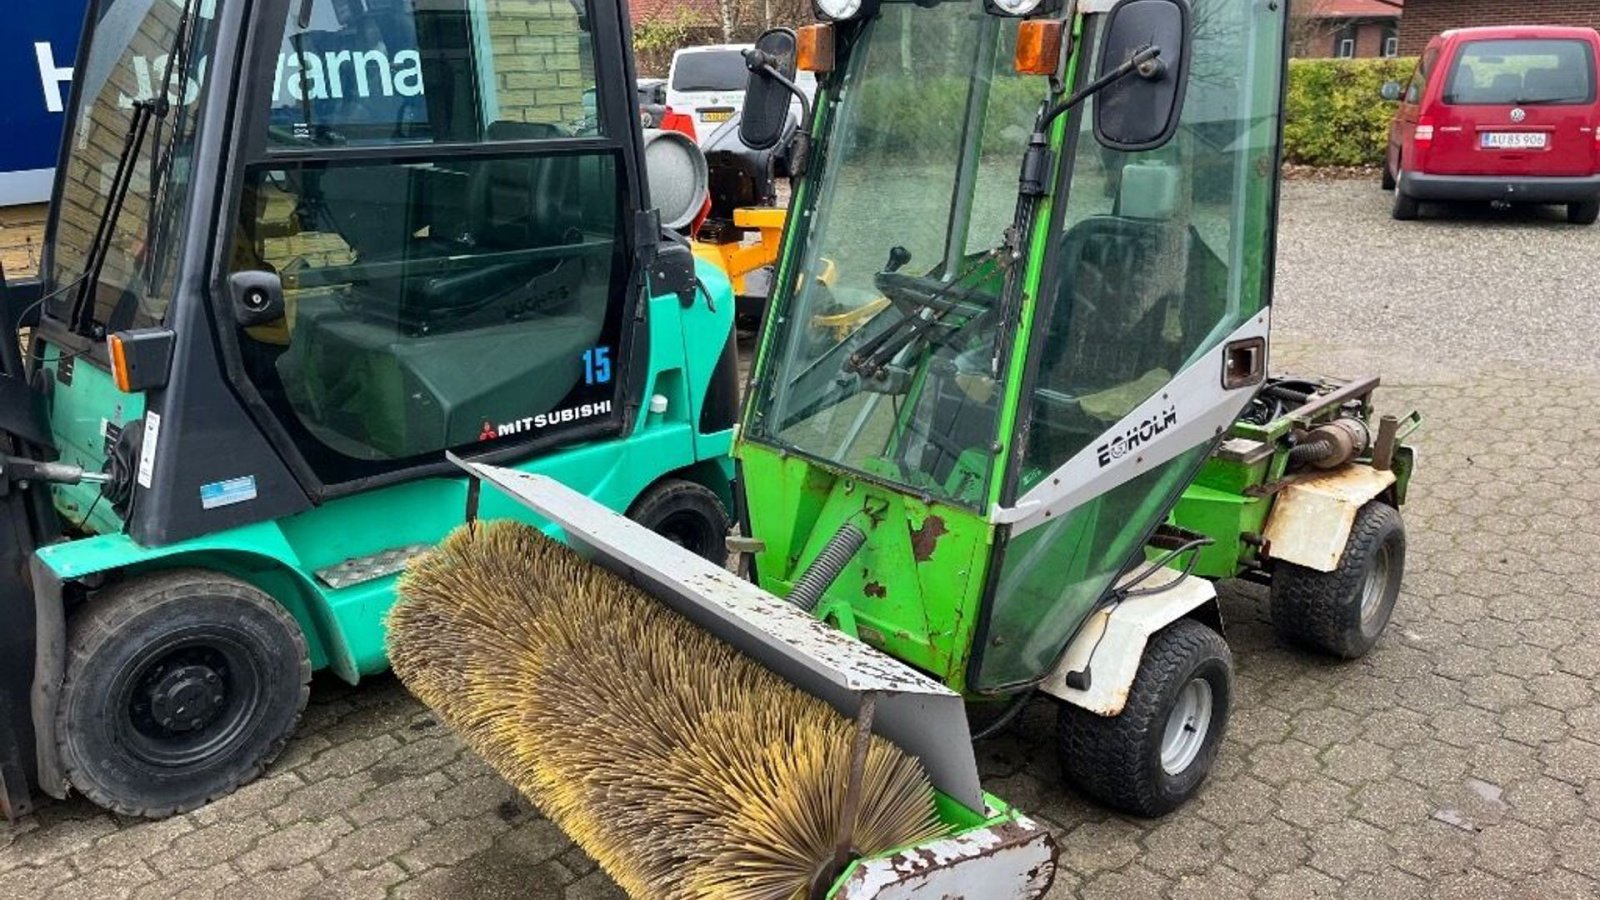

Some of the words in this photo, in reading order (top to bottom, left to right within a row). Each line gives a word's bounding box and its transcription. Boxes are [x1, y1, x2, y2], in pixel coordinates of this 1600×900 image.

[1523, 134, 1544, 145] 906
[582, 347, 611, 385] 15
[497, 399, 612, 437] MITSUBISHI
[1096, 404, 1178, 468] EGHOLM
